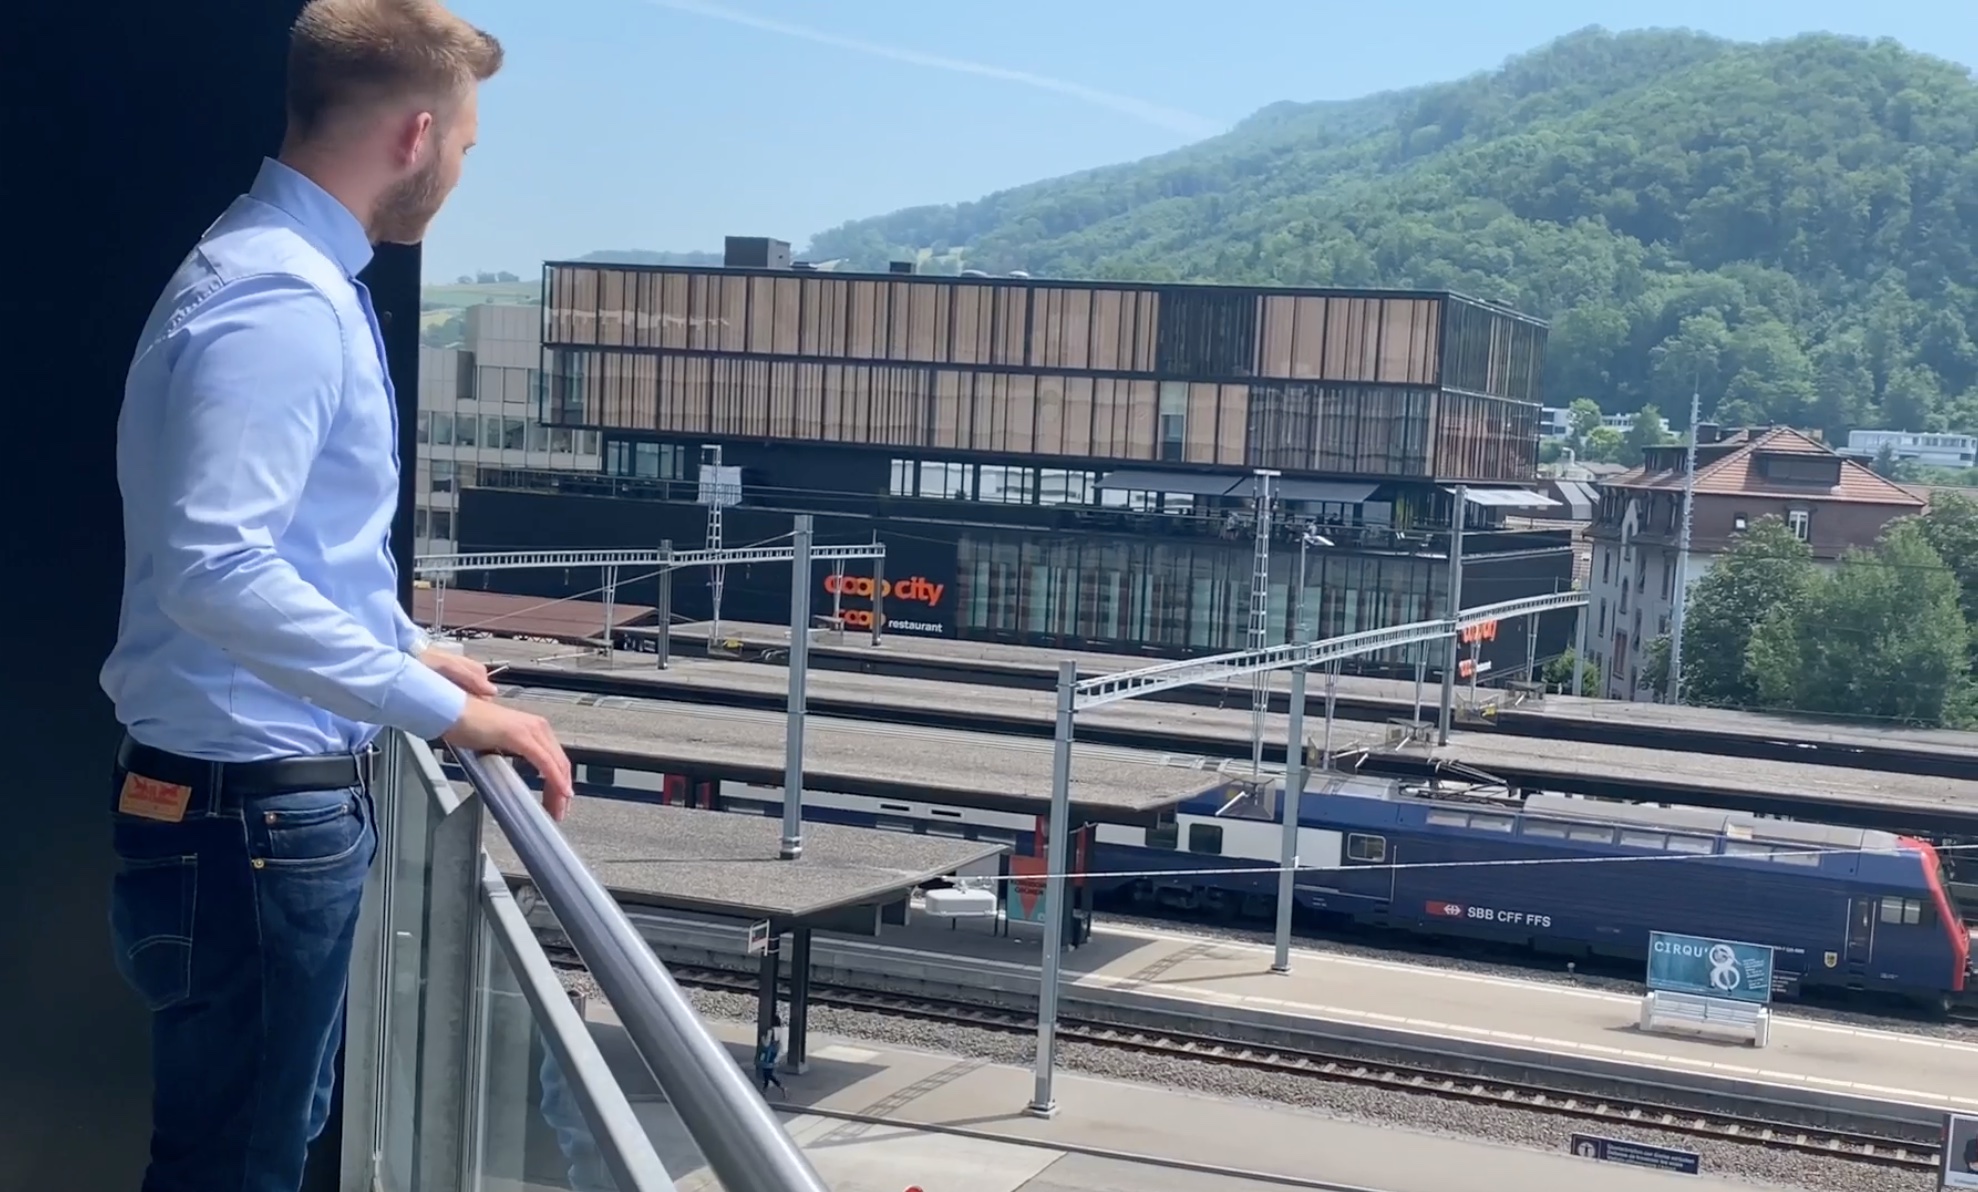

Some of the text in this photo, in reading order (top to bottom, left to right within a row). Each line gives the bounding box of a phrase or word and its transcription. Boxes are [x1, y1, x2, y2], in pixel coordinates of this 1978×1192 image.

[894, 576, 944, 606] city
[888, 619, 943, 633] restaurant
[1467, 907, 1551, 927] SBB CFF FFS
